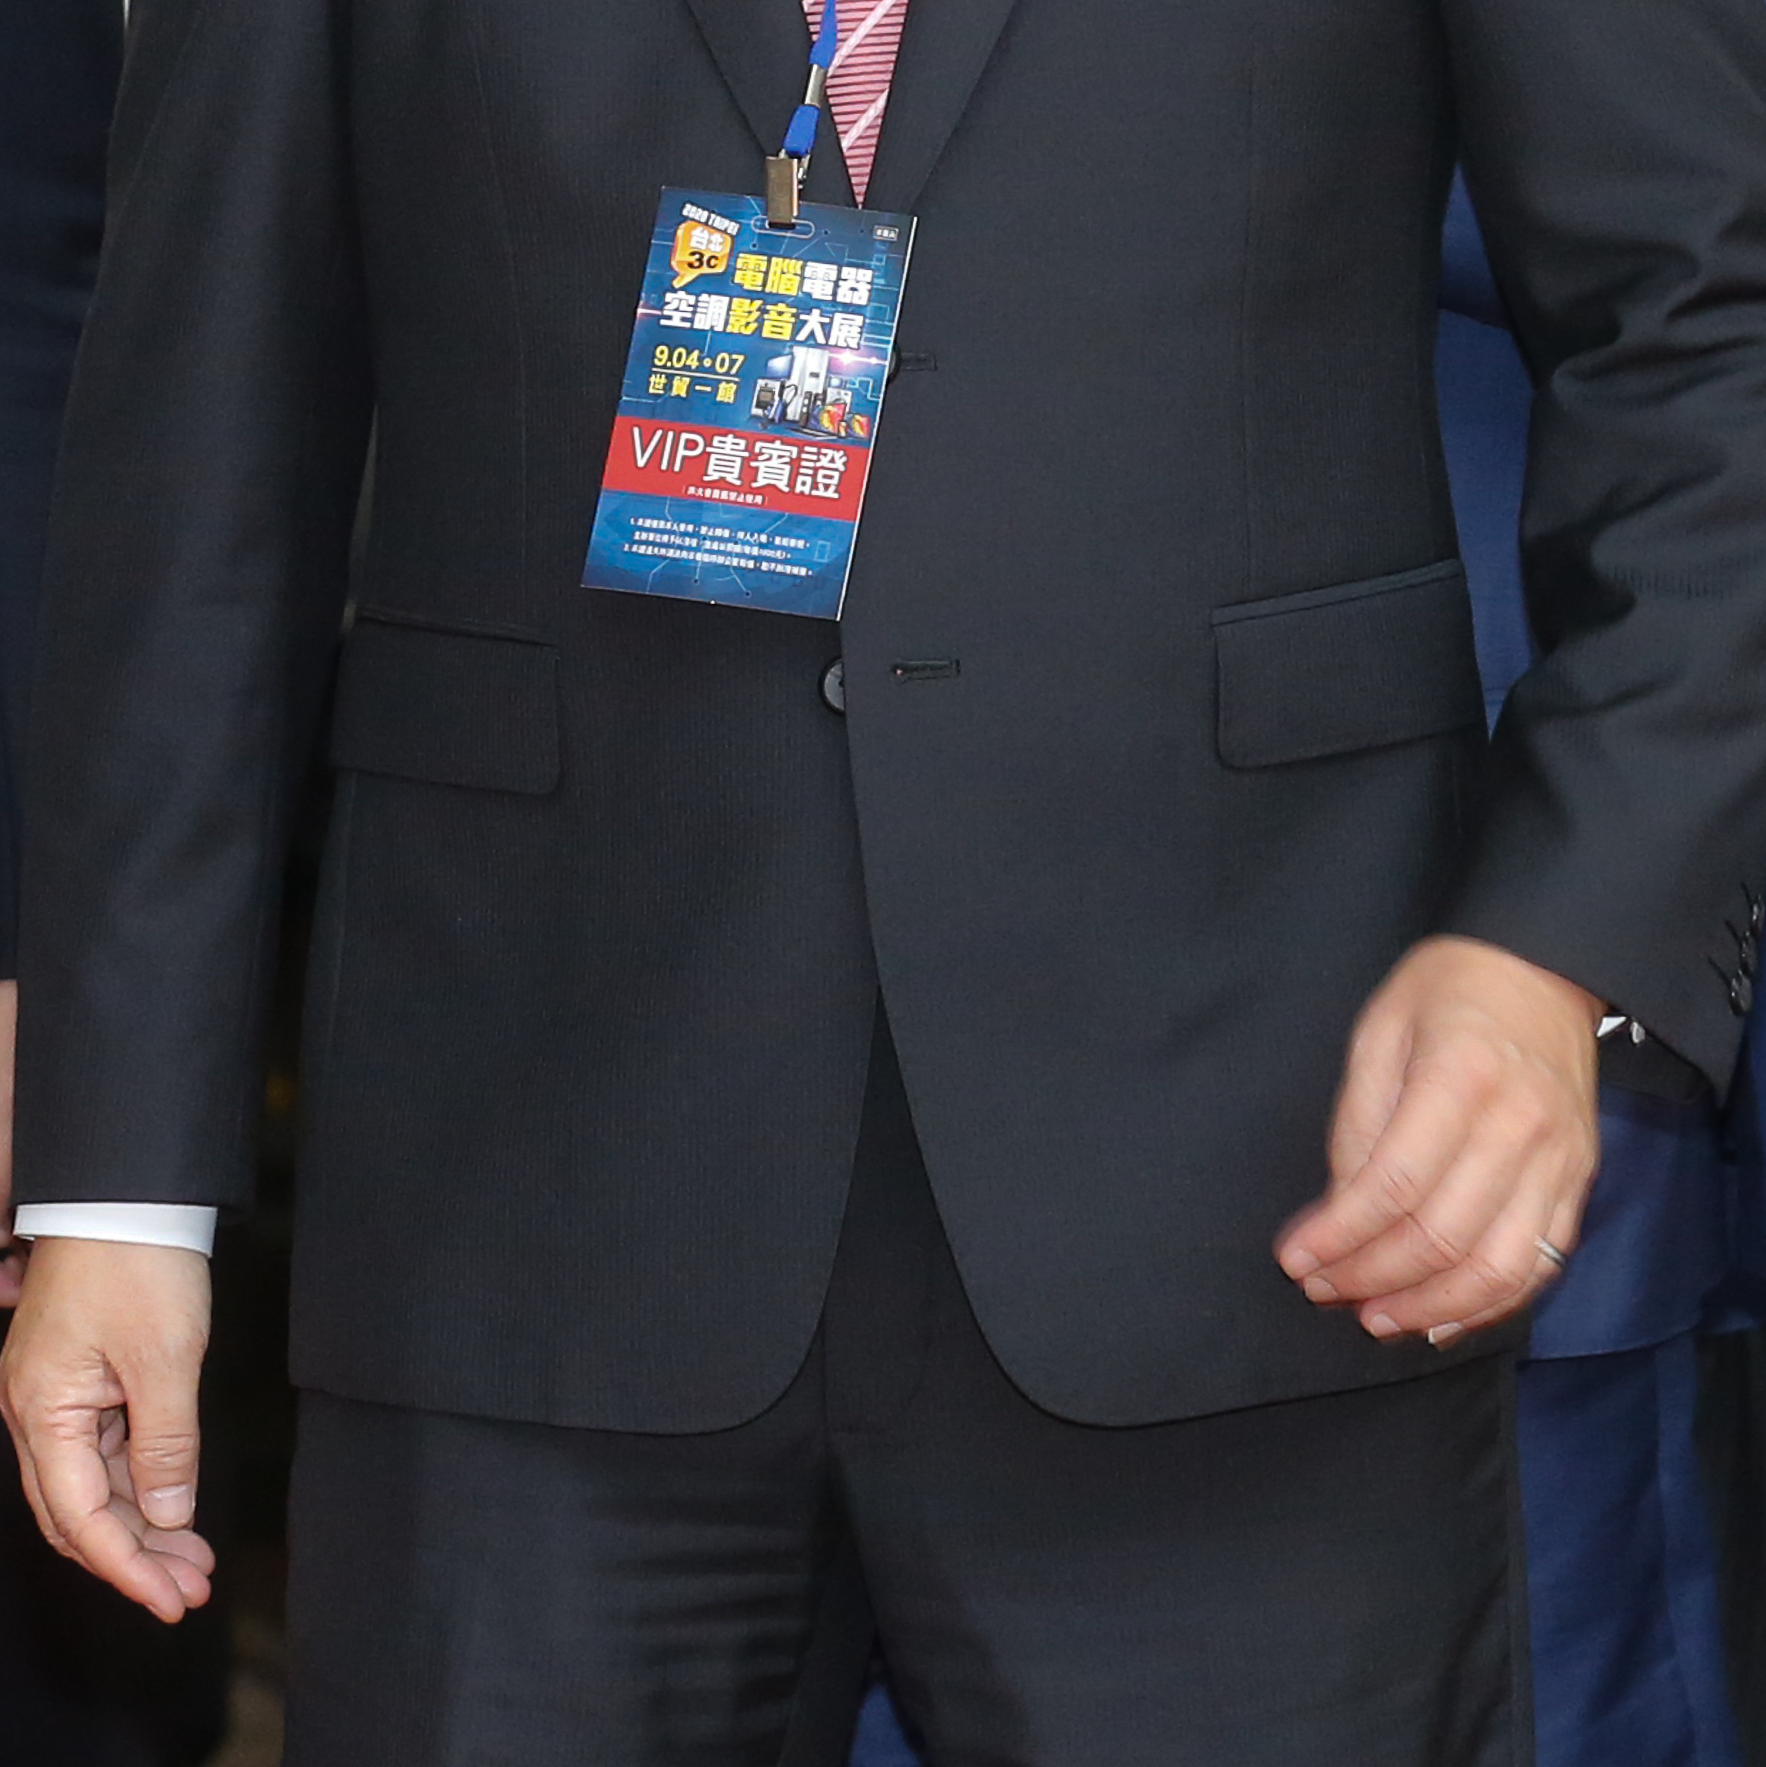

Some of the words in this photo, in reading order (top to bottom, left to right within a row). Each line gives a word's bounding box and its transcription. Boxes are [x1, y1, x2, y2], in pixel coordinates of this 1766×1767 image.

[690, 227, 723, 252] 台北
[733, 253, 874, 306] 電腦電器
[659, 290, 865, 350] 空調影音大展
[649, 373, 738, 404] 世貿一館
